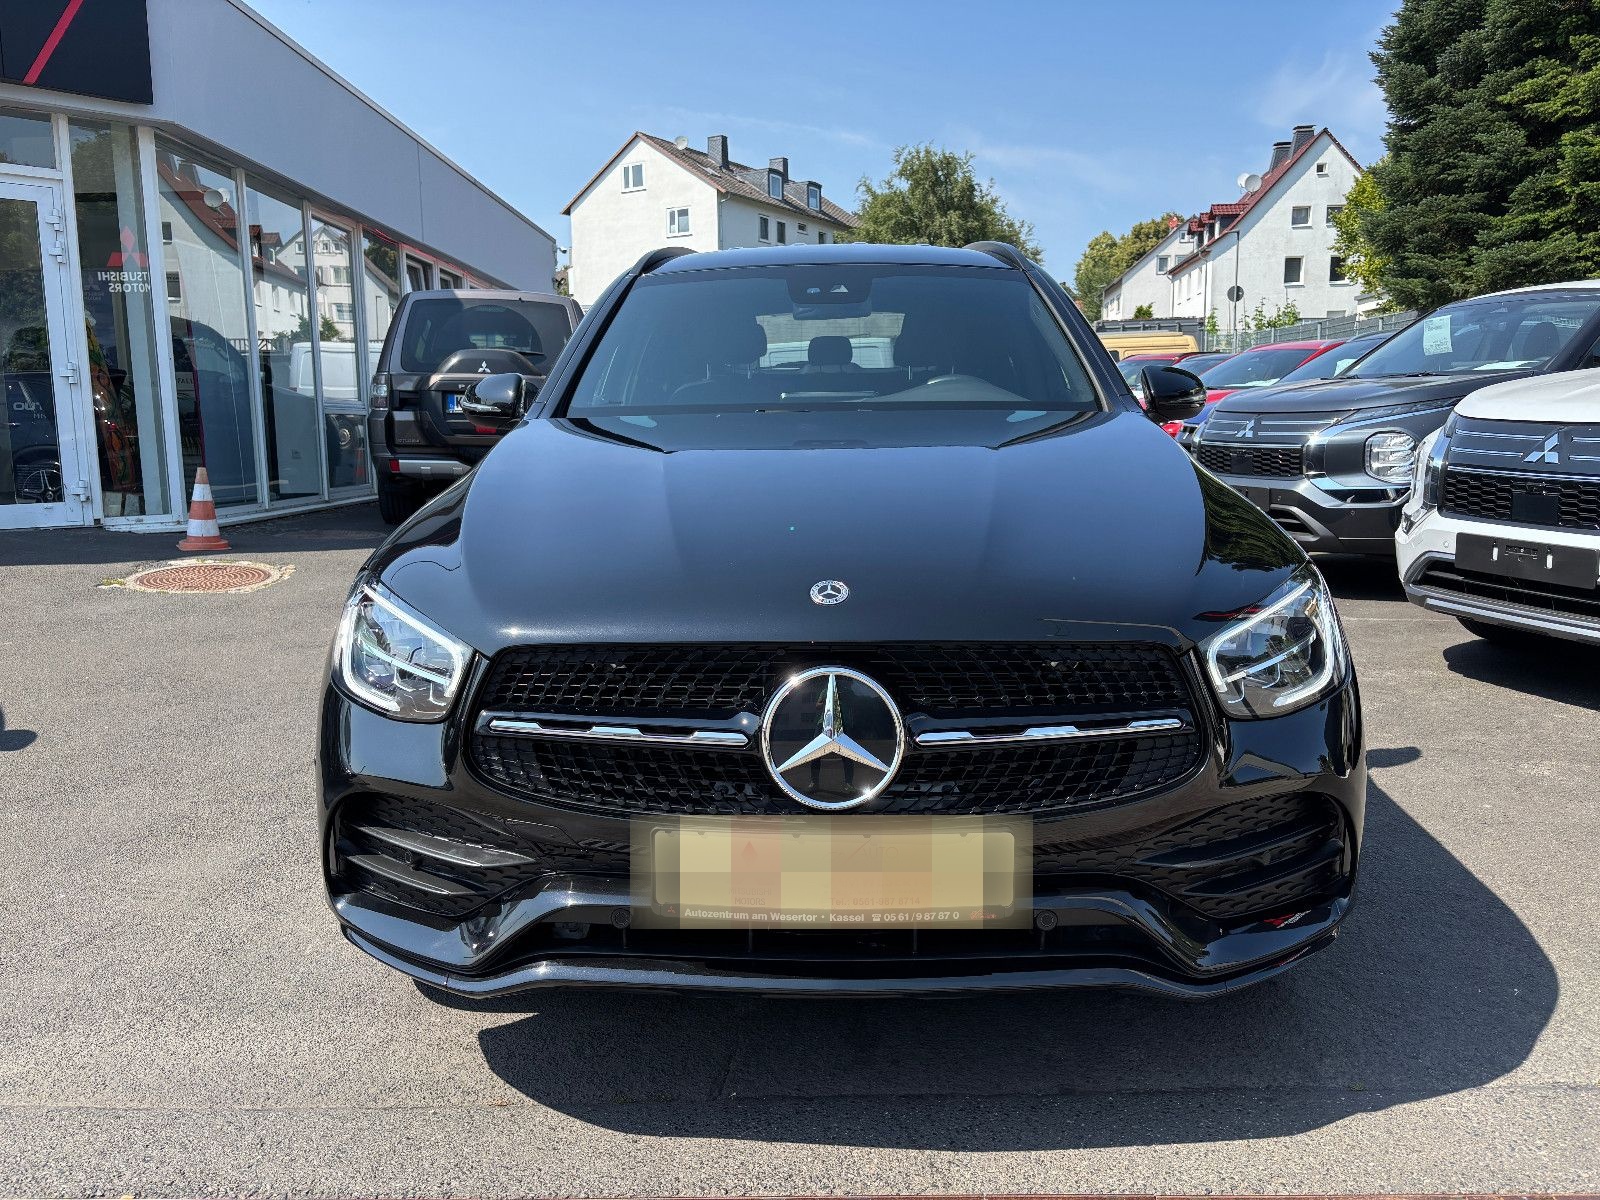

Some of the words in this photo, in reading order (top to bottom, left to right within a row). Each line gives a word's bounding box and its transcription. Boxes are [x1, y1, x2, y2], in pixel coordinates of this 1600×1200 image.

[729, 887, 772, 896] MITSUBISHI
[734, 897, 766, 906] MOTORS
[684, 908, 749, 920] Autozentrum
[752, 913, 768, 921] am
[770, 912, 818, 922] Wesertor
[829, 913, 865, 922] Kassel
